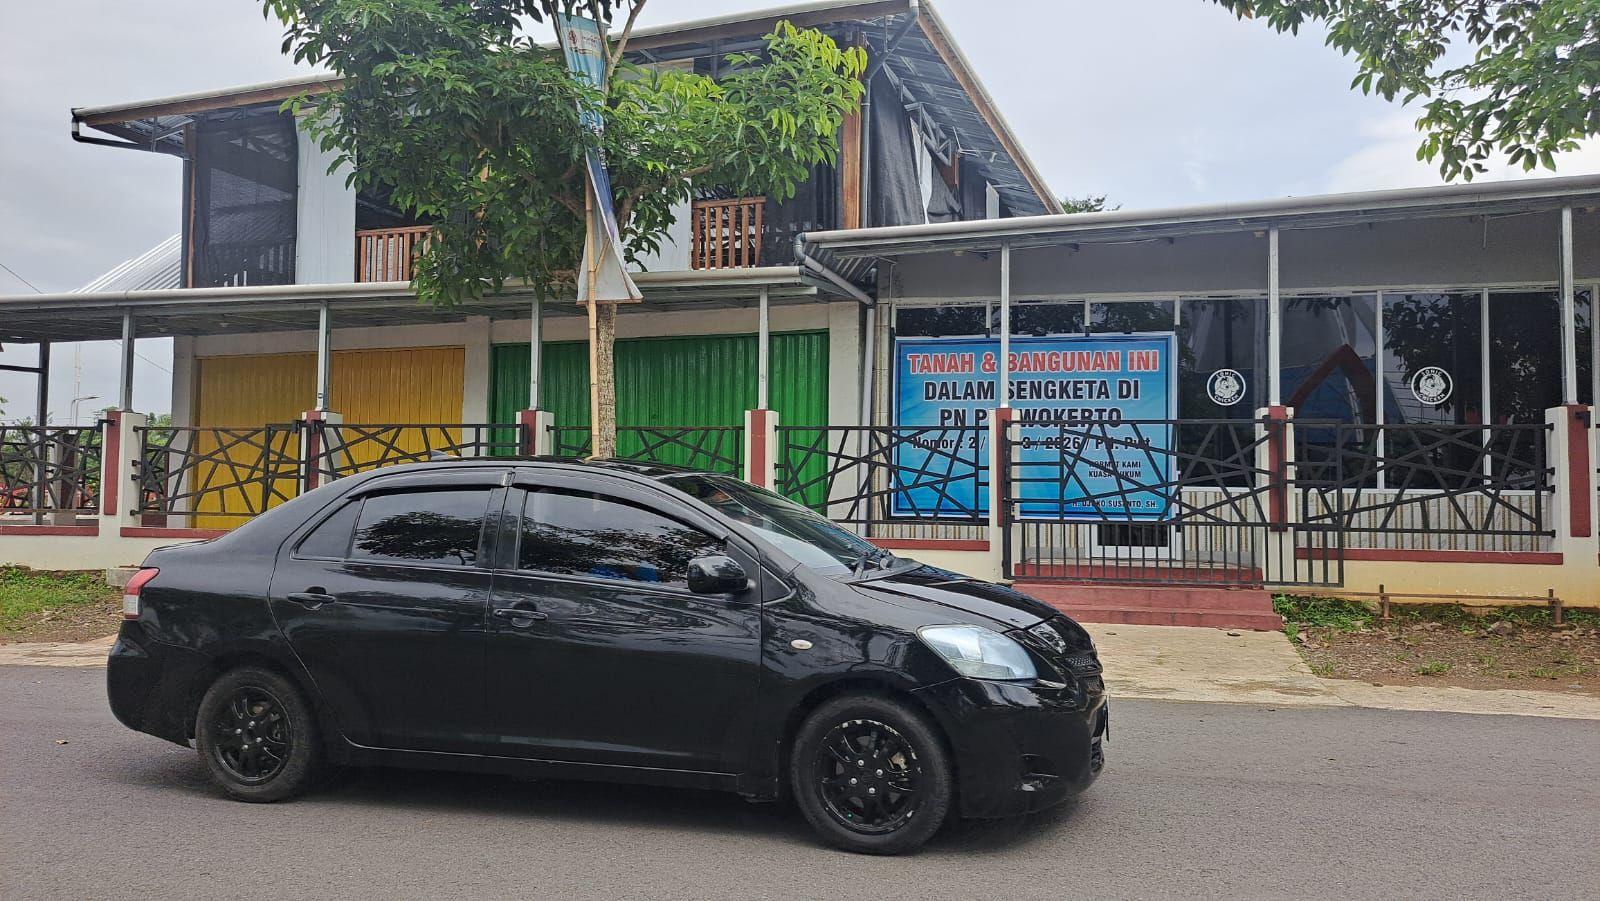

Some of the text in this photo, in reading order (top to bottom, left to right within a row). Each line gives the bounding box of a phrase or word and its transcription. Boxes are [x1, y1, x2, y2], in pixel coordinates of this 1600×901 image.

[908, 350, 1158, 374] TANAH & BANGUNAN INI
[924, 379, 1140, 401] DALAM SENGKETA DI
[940, 408, 1122, 428] PN PWOKERTO
[1122, 461, 1141, 469] KAMI
[1088, 470, 1142, 478] KUASA UKUM
[1108, 500, 1144, 509] SUSNTO,
